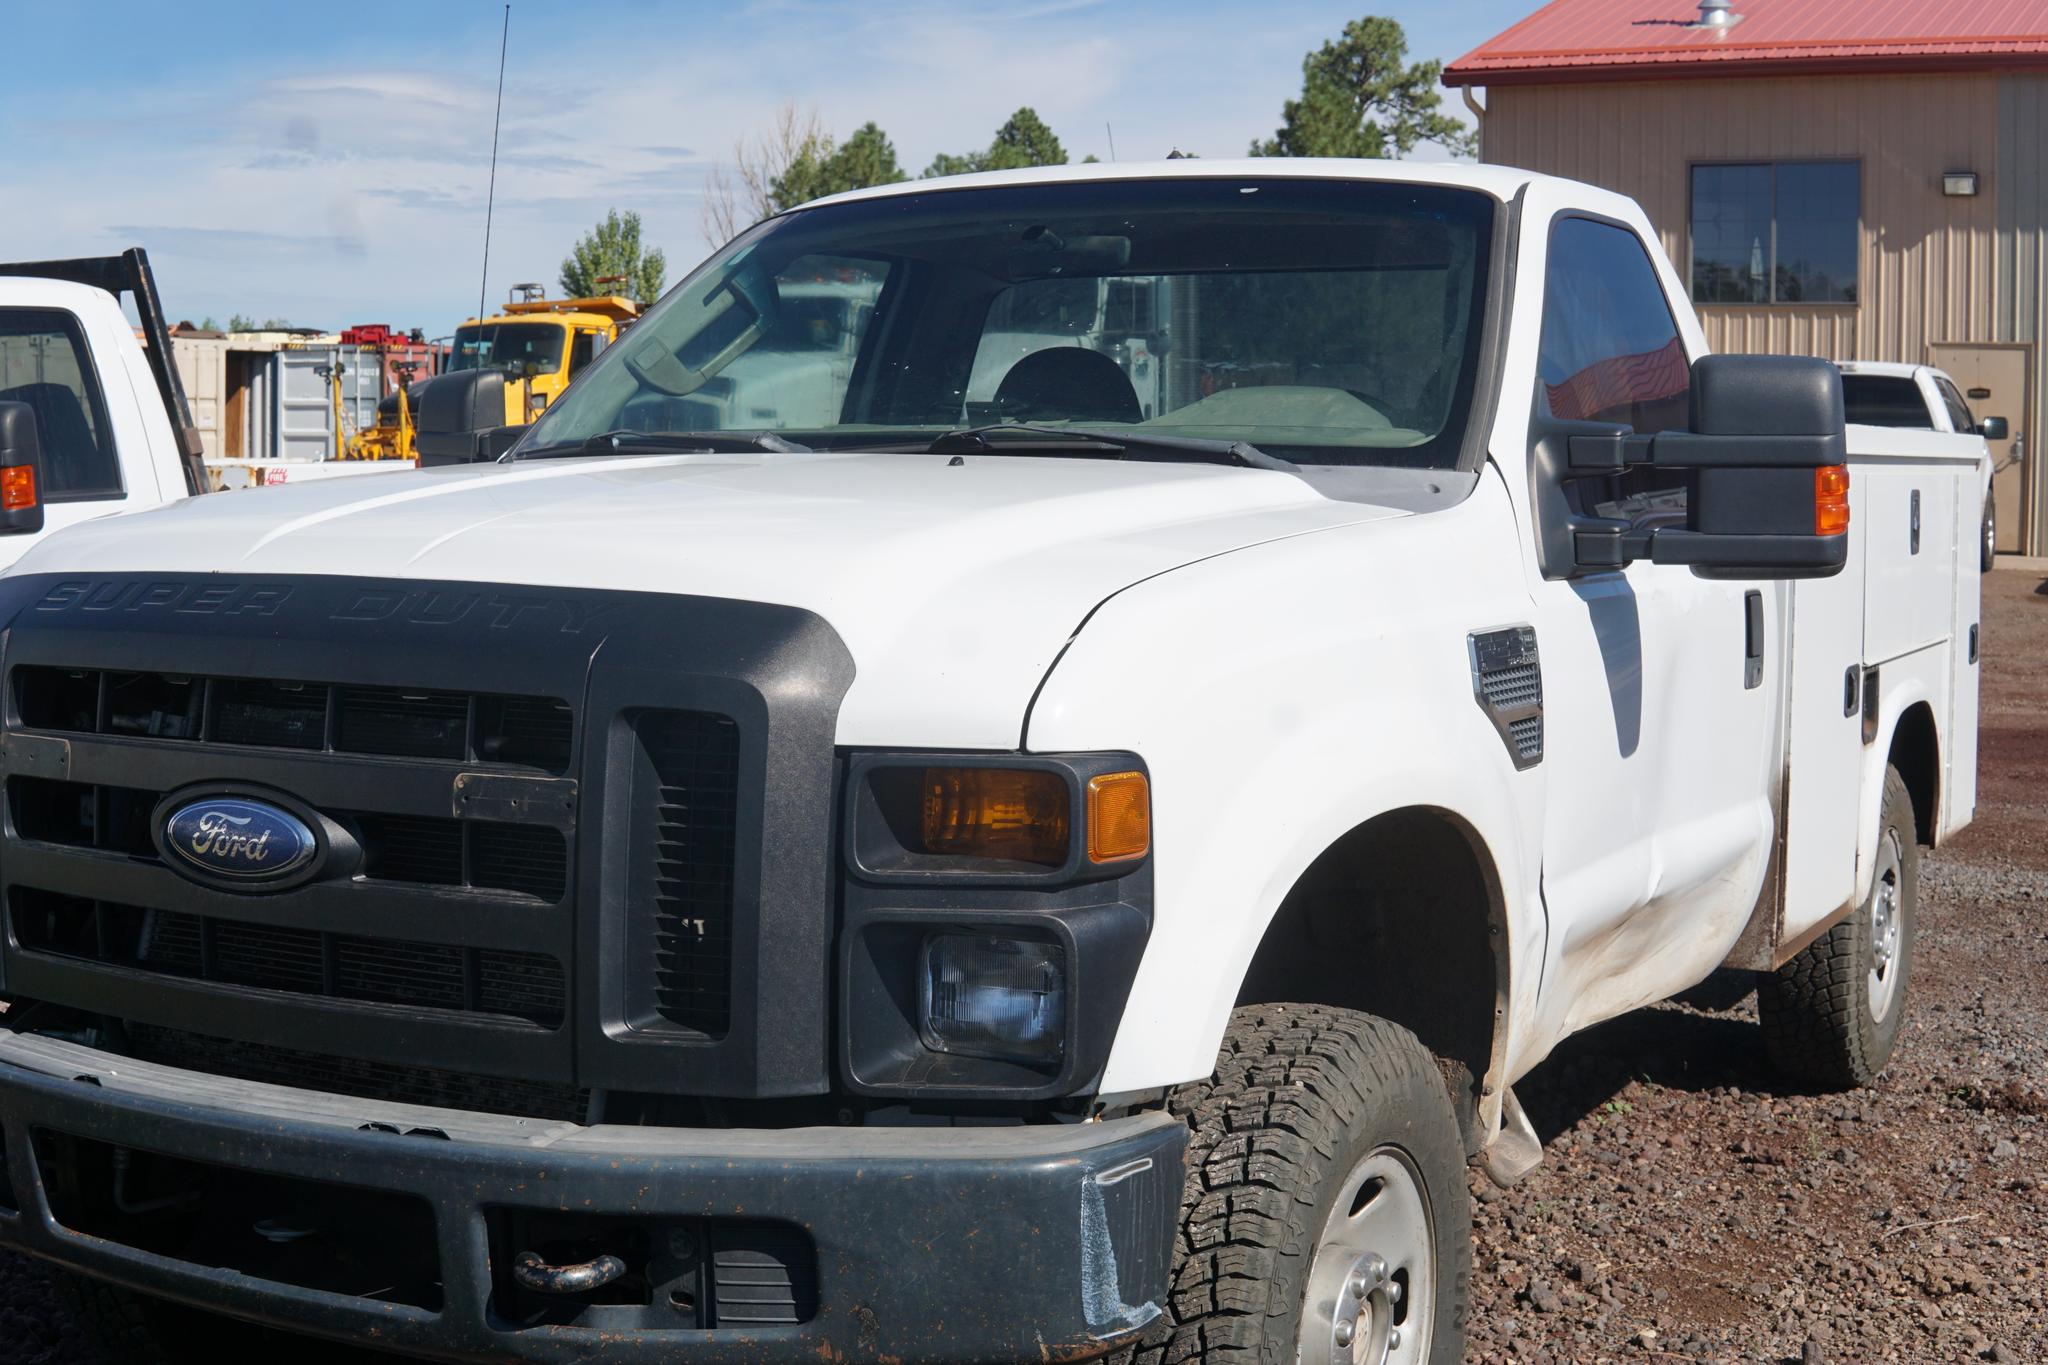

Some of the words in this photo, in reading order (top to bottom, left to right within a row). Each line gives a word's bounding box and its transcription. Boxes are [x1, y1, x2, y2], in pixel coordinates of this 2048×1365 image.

[35, 580, 297, 616] SUPER
[328, 588, 618, 633] DUTY
[192, 811, 271, 861] Ford
